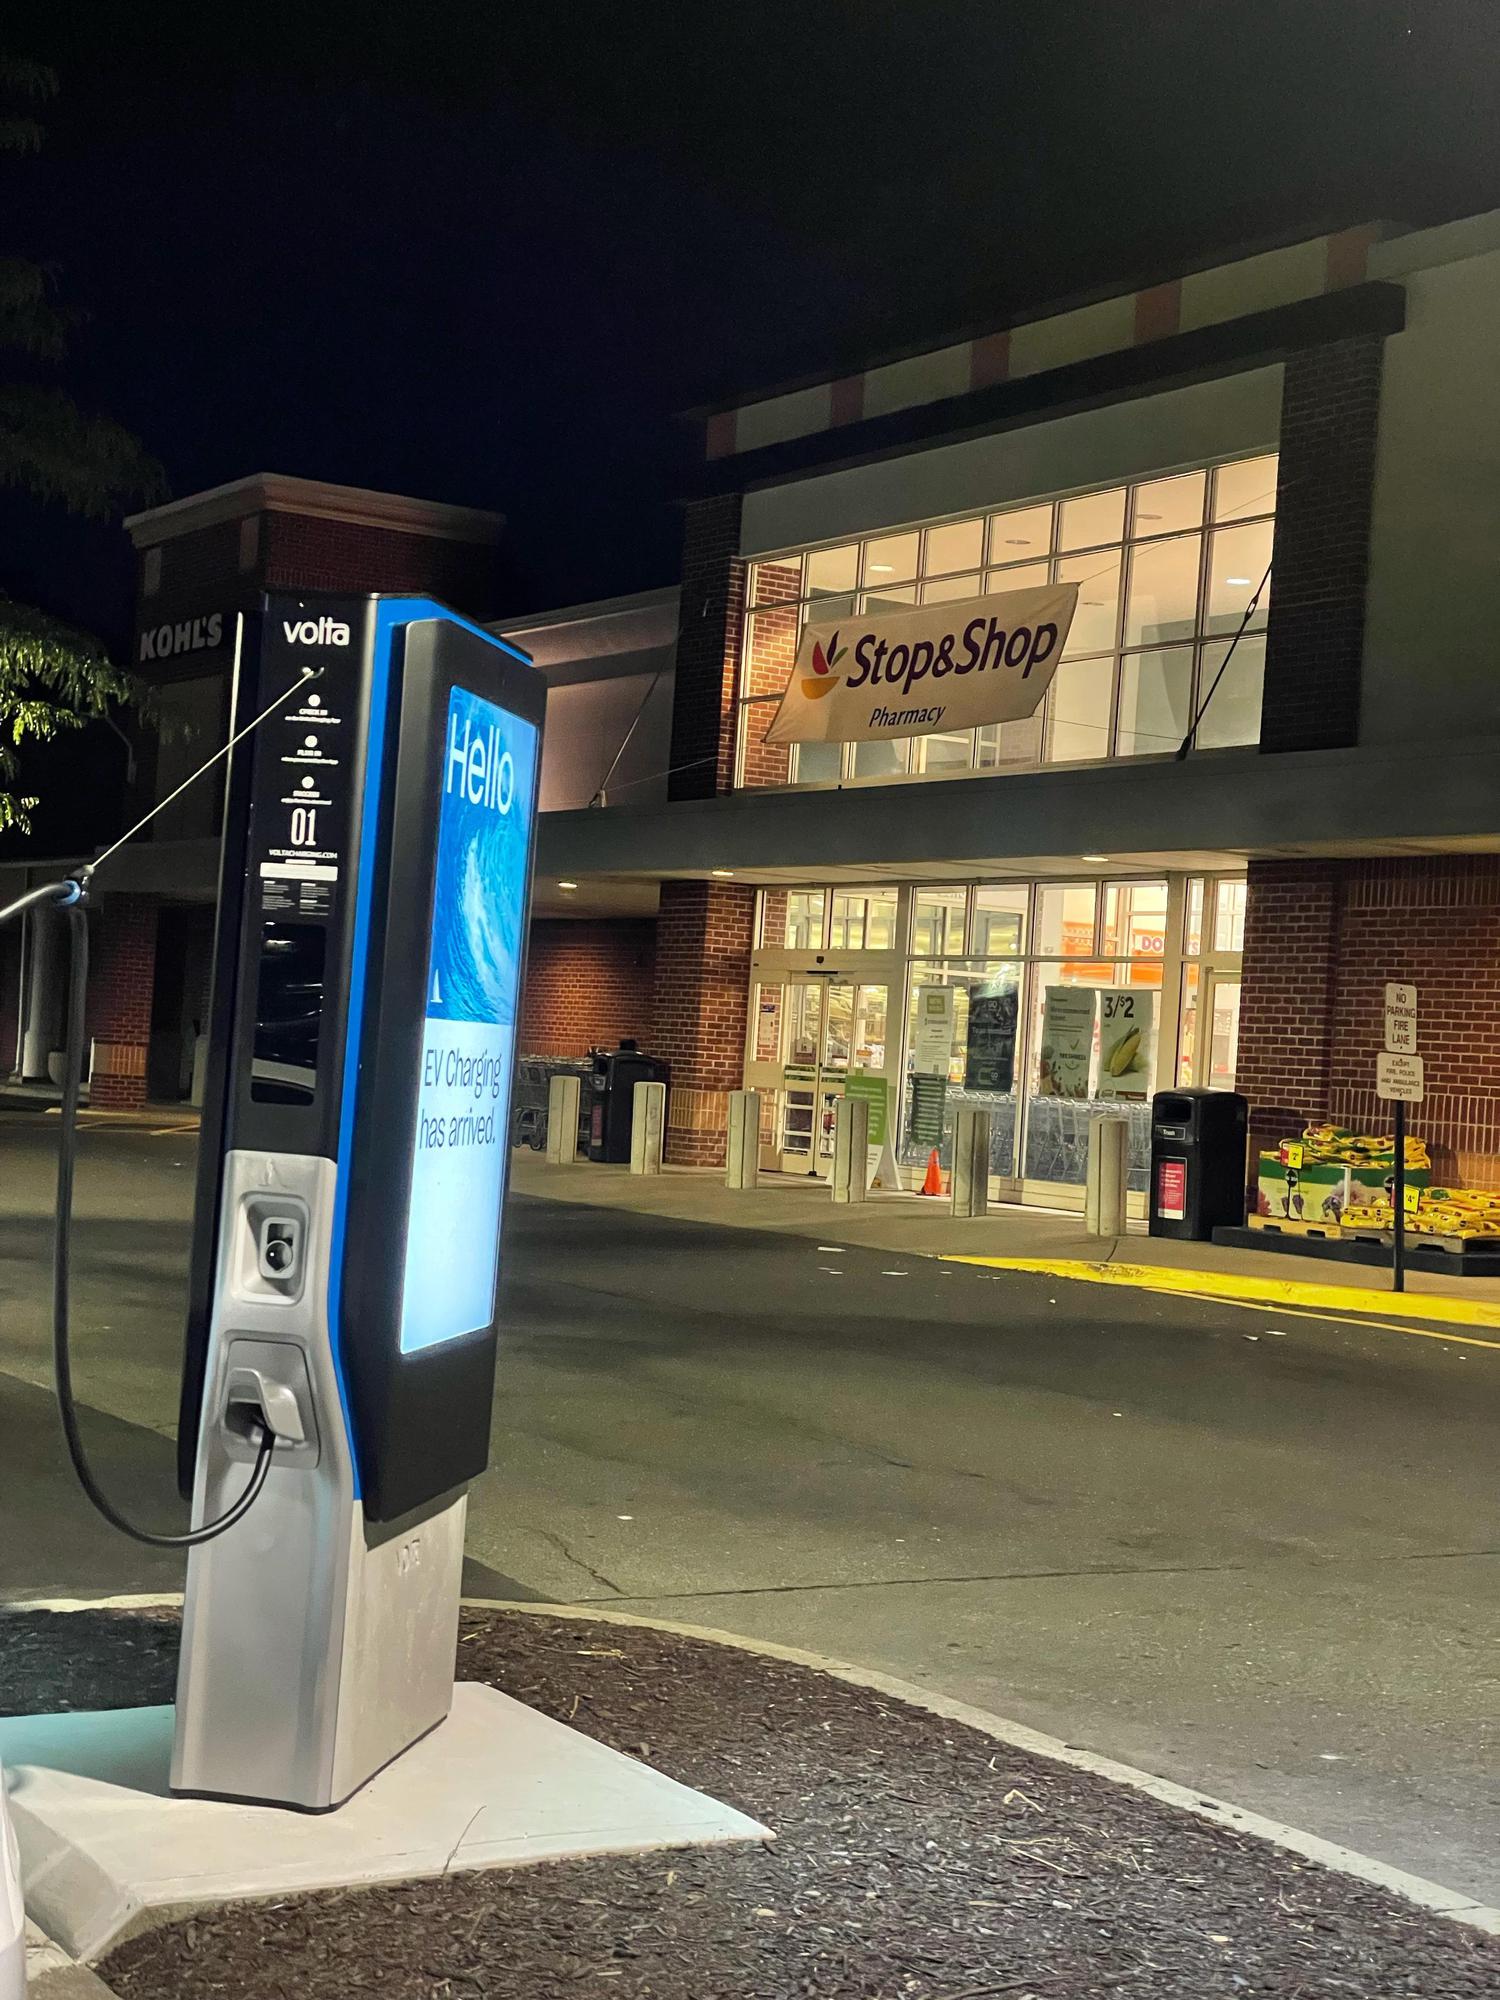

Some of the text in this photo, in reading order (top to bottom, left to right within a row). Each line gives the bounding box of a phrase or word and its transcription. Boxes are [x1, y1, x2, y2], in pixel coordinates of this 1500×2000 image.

[139, 612, 223, 662] KOHL'S
[283, 616, 350, 646] volta
[846, 616, 1058, 695] Stop&Shop
[869, 704, 946, 728] Pharmacy
[447, 712, 514, 815] Hello
[291, 807, 317, 846] 01
[1386, 1005, 1416, 1018] PARKING
[1396, 993, 1407, 1004] NO
[1392, 1033, 1410, 1045] LANE
[1393, 1019, 1409, 1031] FIRE
[424, 1047, 502, 1099] EV Charging
[1399, 1069, 1416, 1077] POLICE
[419, 1107, 495, 1150] has arrived.
